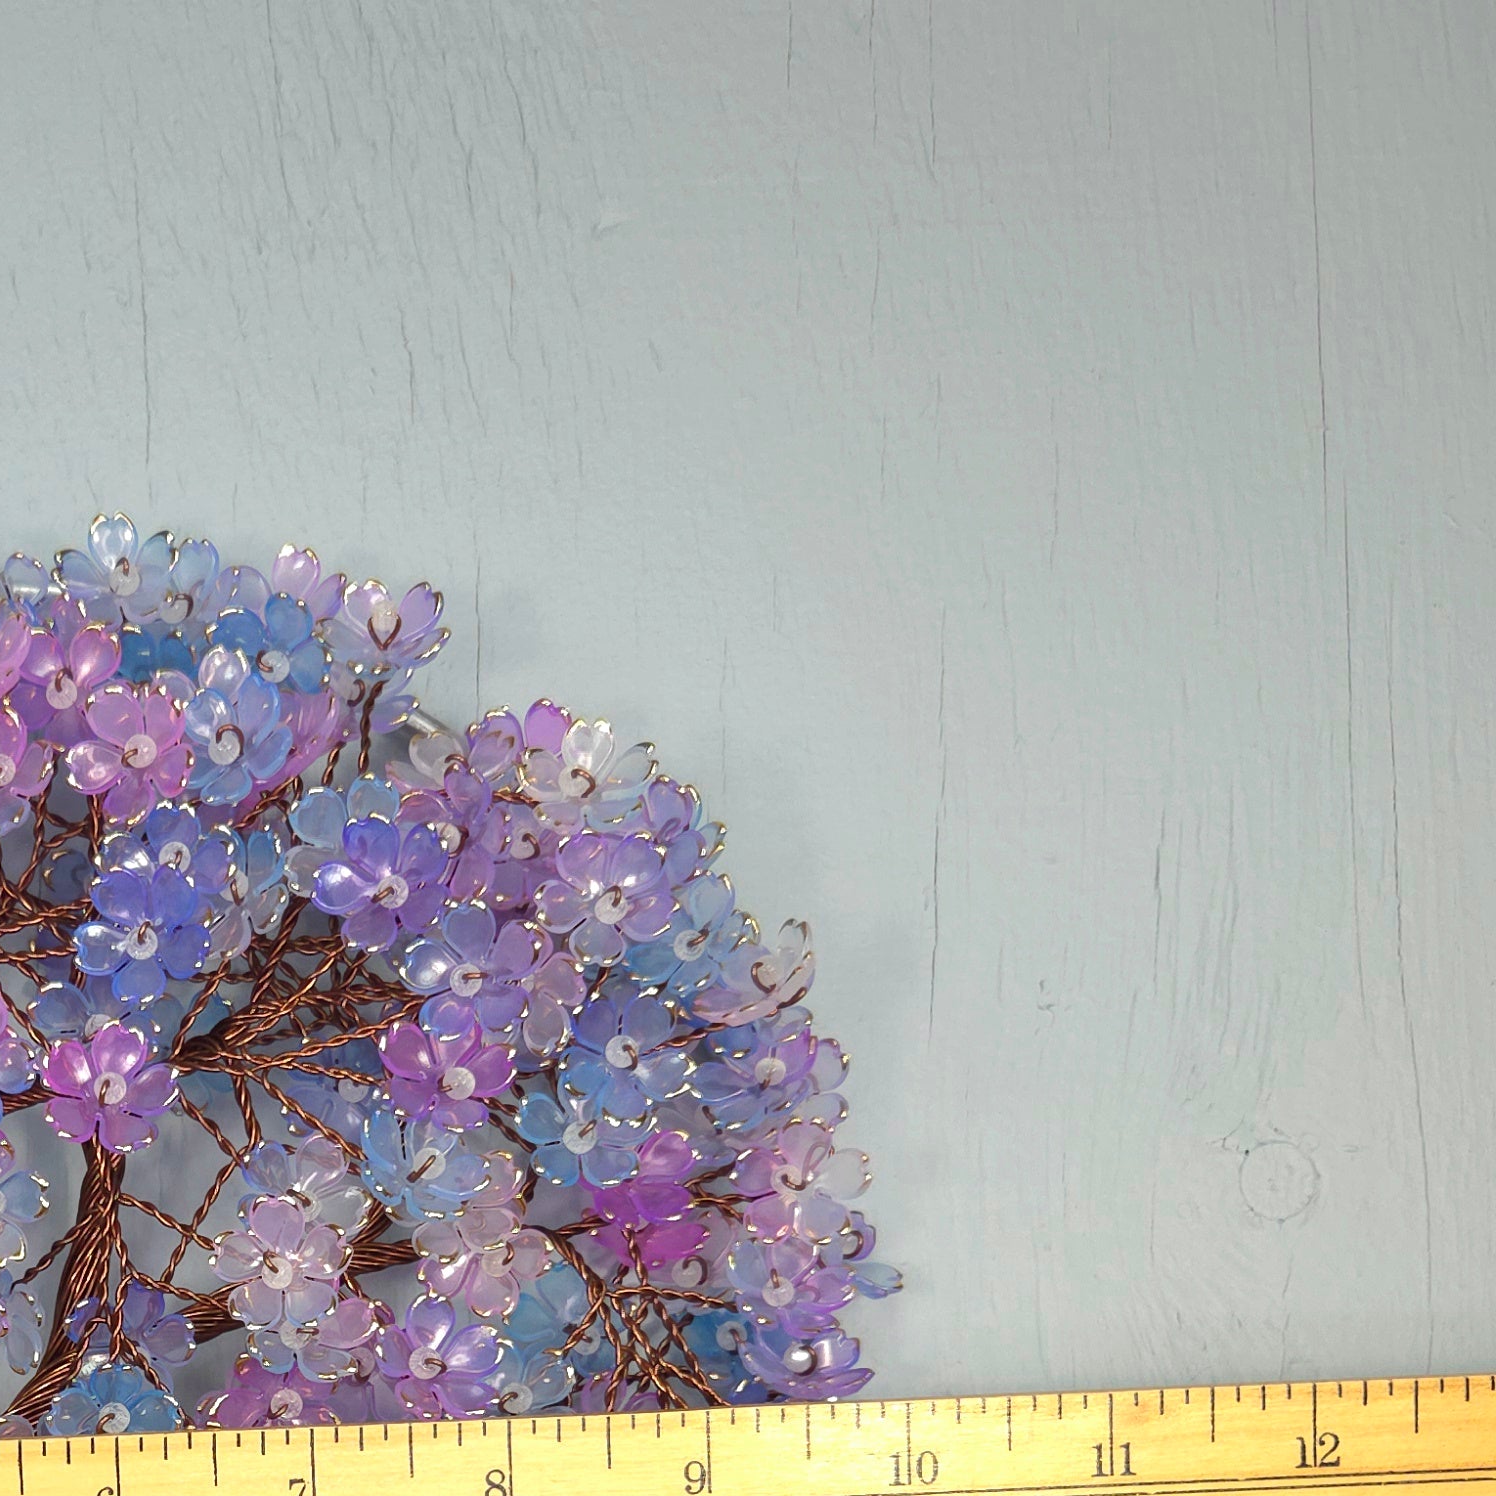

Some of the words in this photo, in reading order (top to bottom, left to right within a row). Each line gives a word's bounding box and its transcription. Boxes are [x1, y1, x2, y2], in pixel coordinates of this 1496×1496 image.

[683, 1460, 707, 1495] 9
[888, 1450, 940, 1487] 10
[1091, 1441, 1138, 1478] 11
[1295, 1431, 1341, 1469] 12
